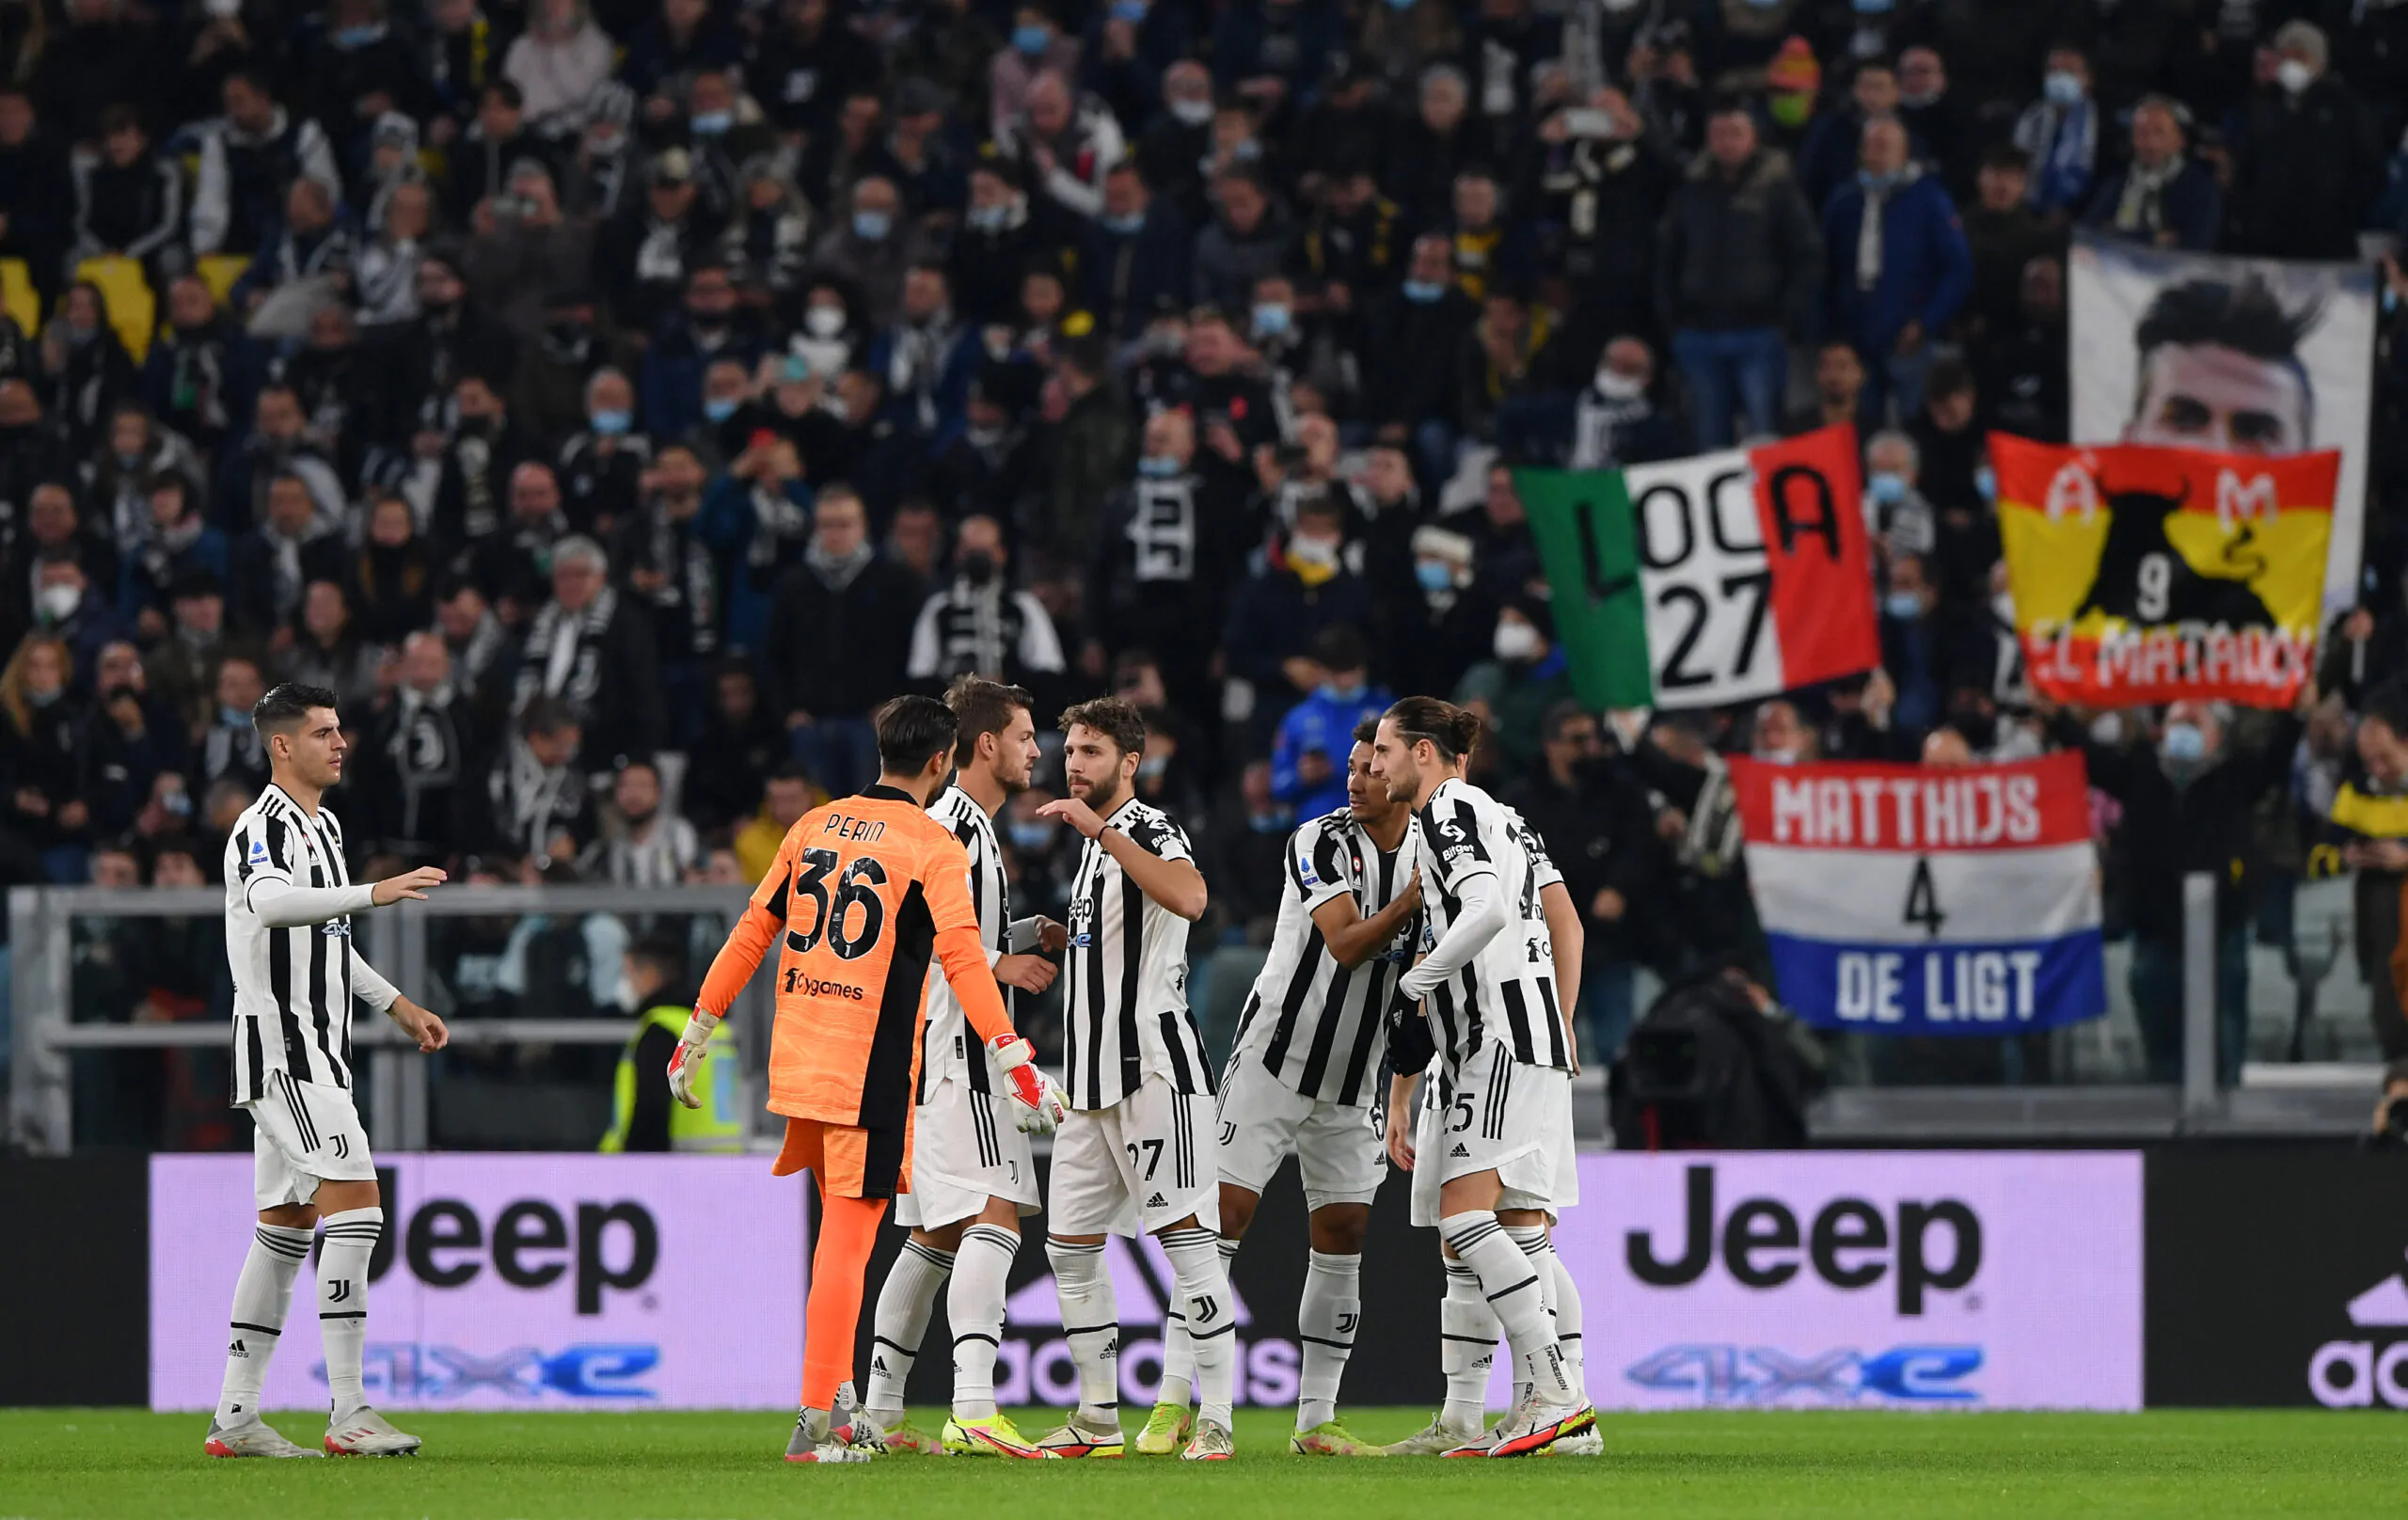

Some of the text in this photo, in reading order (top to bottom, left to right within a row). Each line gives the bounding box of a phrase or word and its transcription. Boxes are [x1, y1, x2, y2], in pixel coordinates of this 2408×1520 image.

[1575, 466, 1840, 602] LOCA
[2215, 468, 2276, 534] M
[2136, 552, 2171, 621] 9
[1658, 572, 1772, 689] 27
[824, 814, 886, 842] PERIN
[1771, 774, 2043, 847] MATTHIJS
[1442, 844, 1475, 863] Bitget
[786, 847, 888, 961] 36
[1069, 896, 1094, 924] eep
[1903, 852, 1946, 941] 4
[797, 973, 863, 1001] Cygames
[1835, 950, 2043, 1022] DE LIGT
[1624, 1165, 1982, 1315] Jeep
